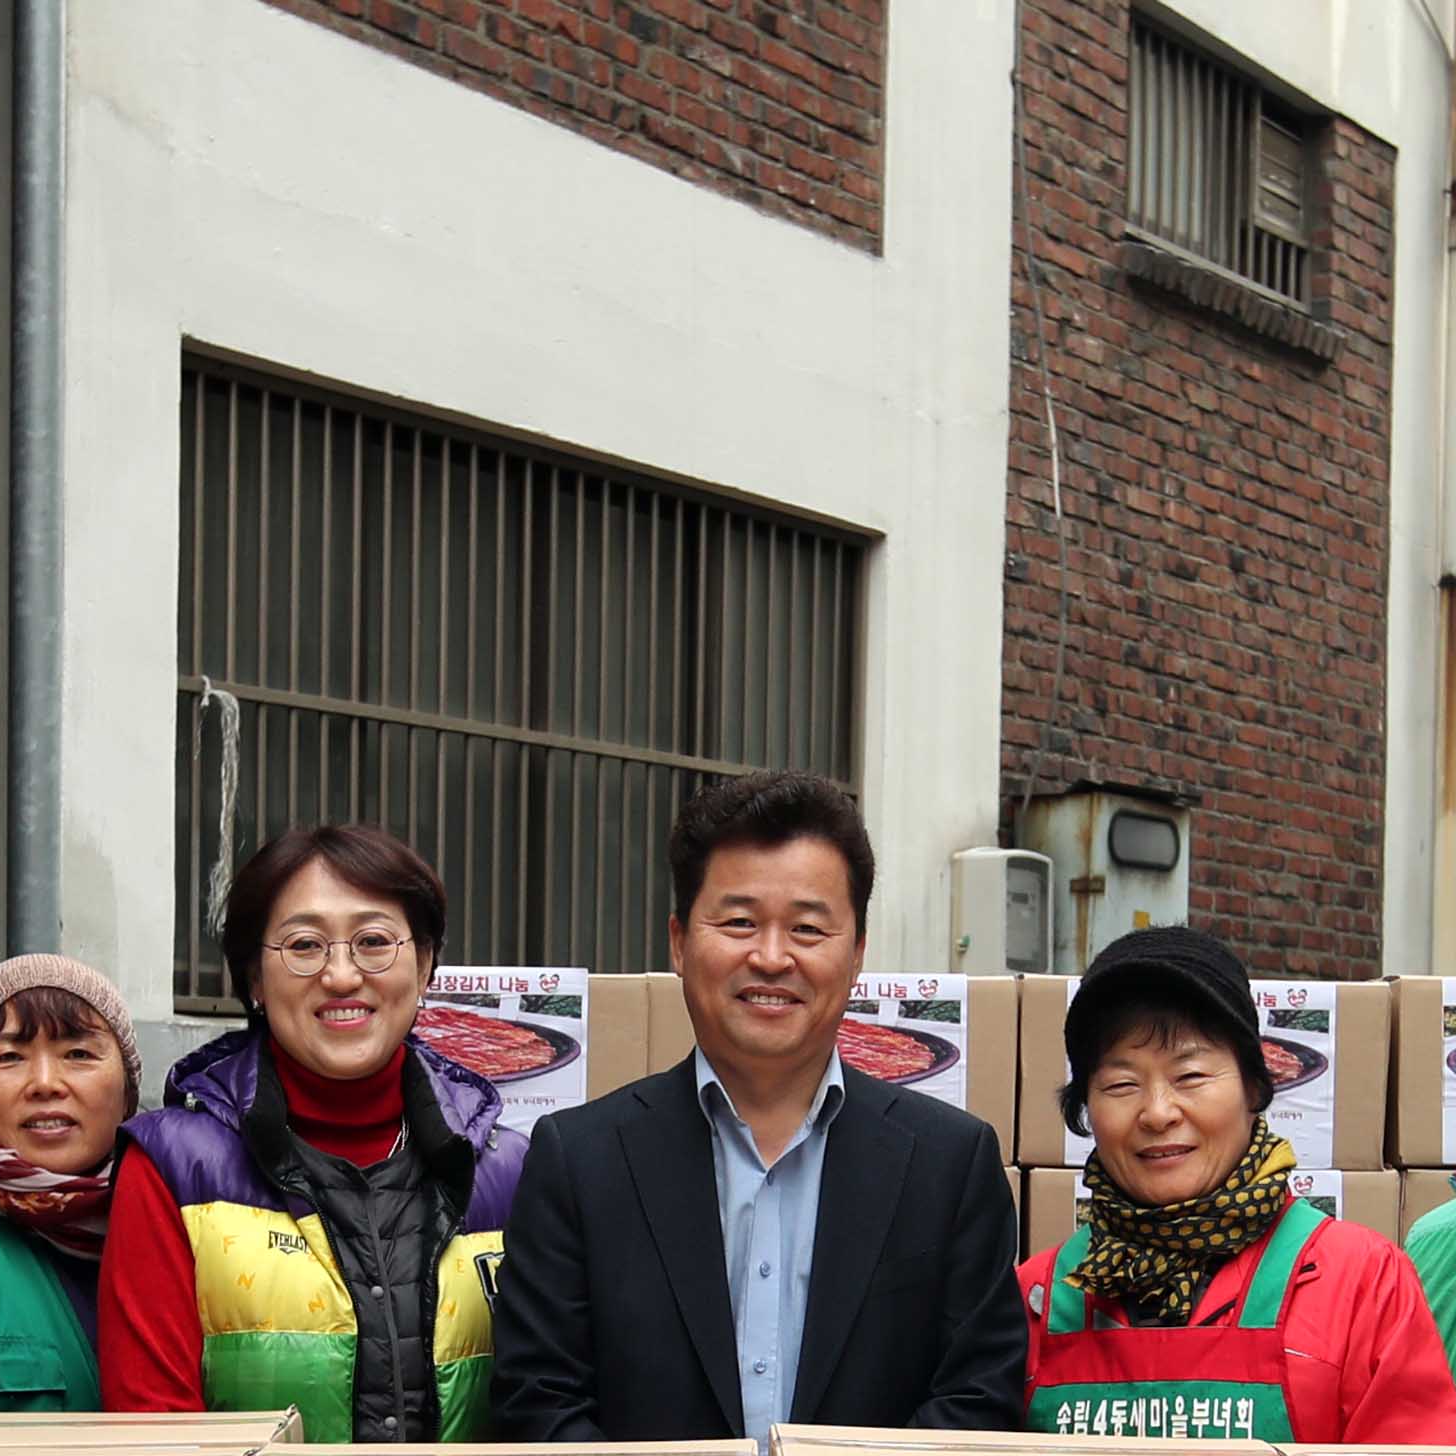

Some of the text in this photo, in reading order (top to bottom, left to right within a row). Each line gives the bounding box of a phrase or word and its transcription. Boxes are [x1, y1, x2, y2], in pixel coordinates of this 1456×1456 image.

[499, 976, 529, 992] 나눔
[878, 983, 907, 998] 나눔
[268, 1230, 309, 1254] EVERLAST
[1056, 1395, 1254, 1440] 송림4동새마을부녀회
